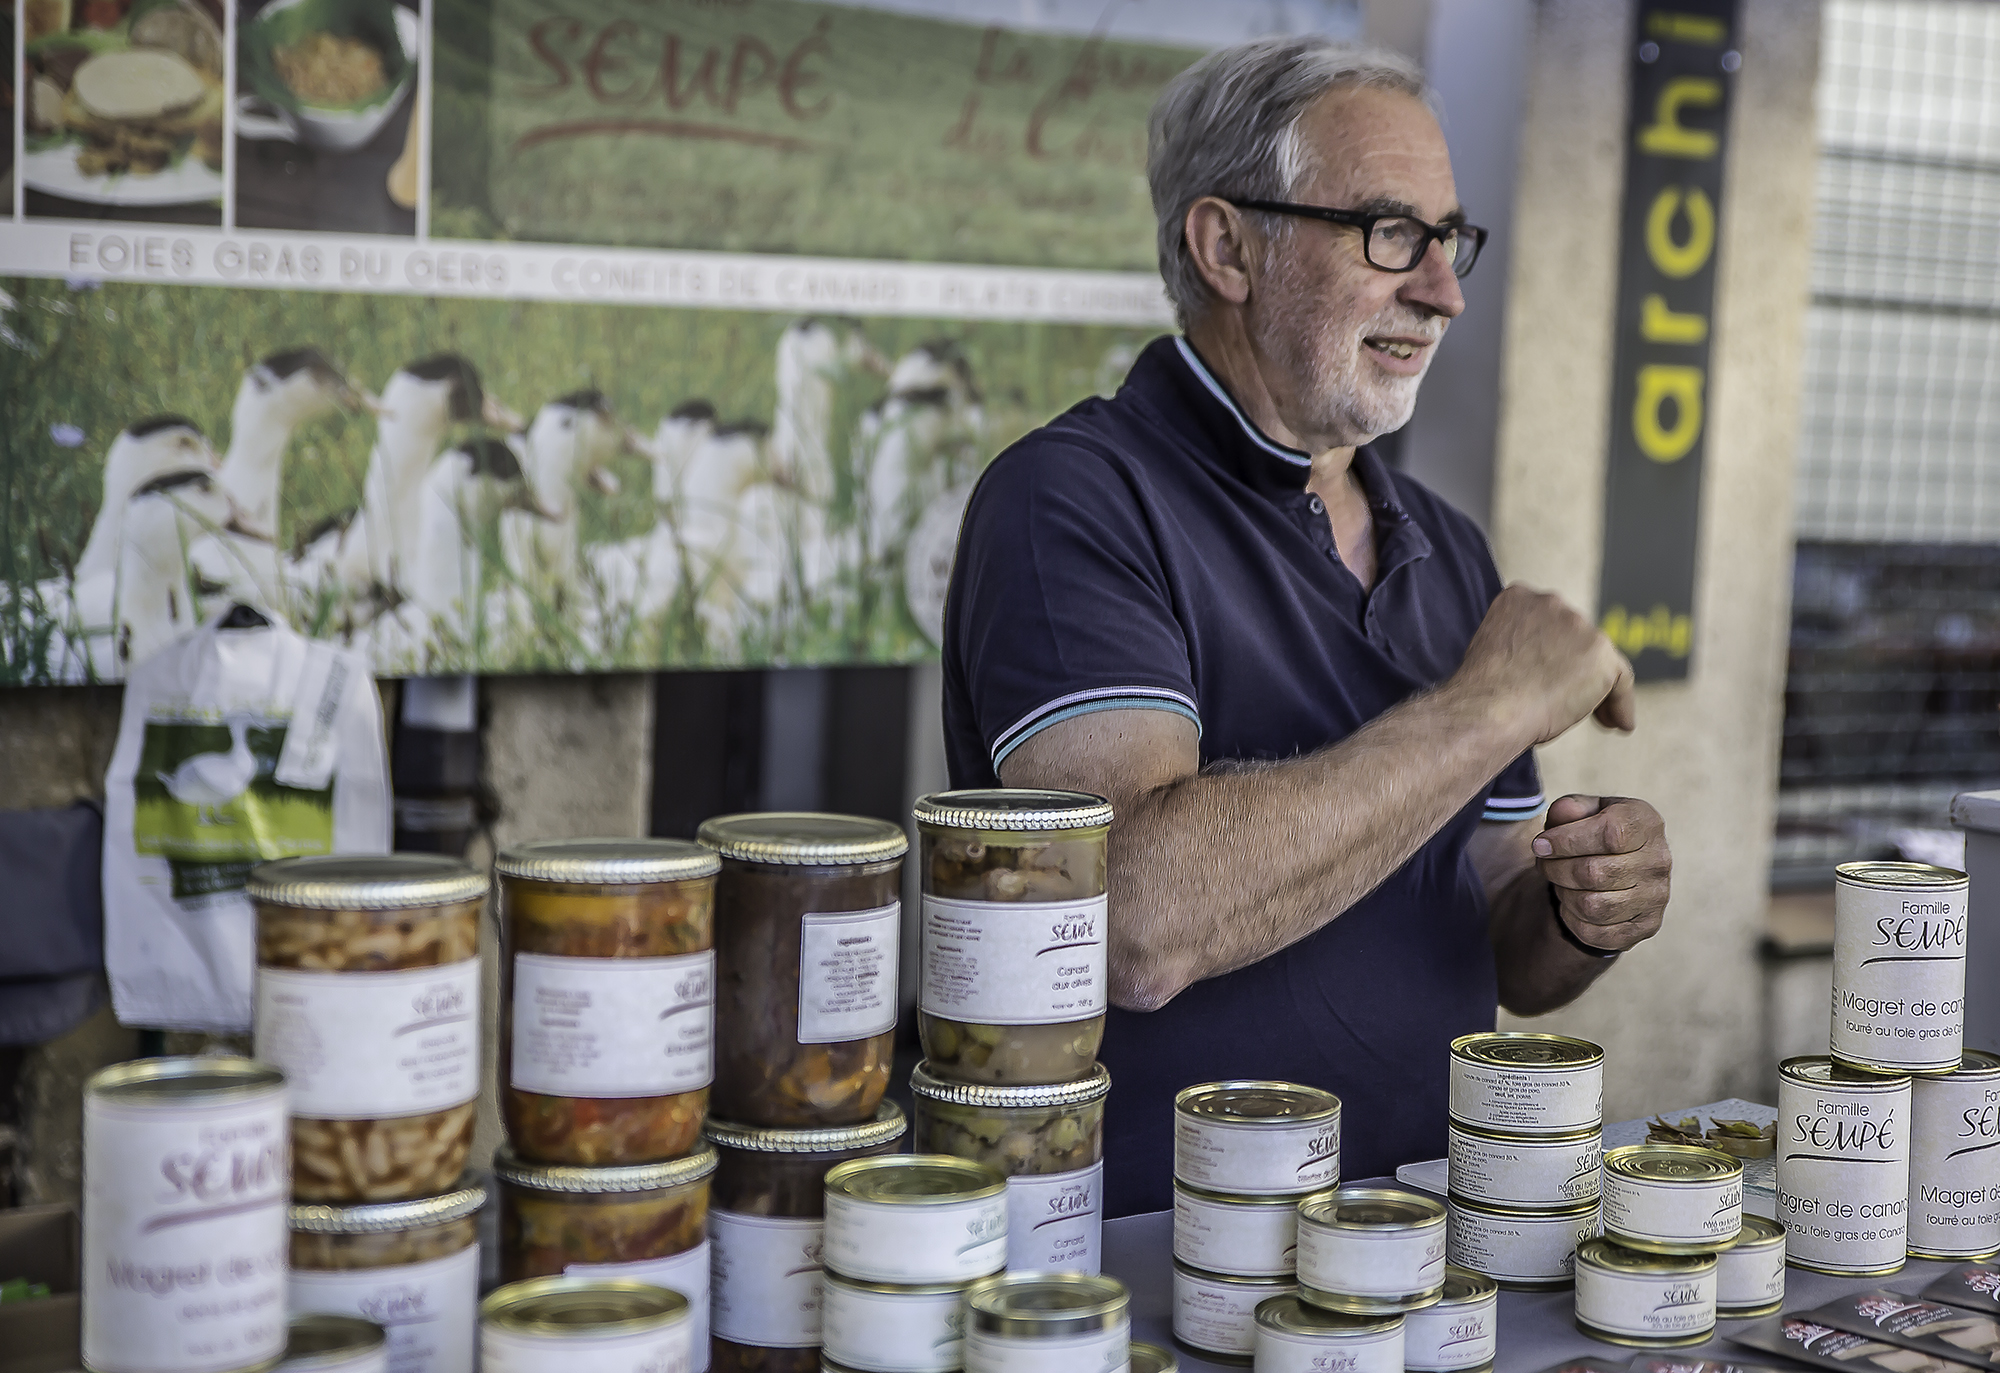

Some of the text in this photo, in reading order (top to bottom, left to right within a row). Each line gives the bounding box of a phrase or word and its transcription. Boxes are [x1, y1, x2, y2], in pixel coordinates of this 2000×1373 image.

[512, 12, 839, 122] SEMPÉ
[1633, 12, 1726, 464] archi
[68, 233, 197, 275] FOIES
[212, 240, 325, 283] GRAS
[339, 247, 392, 286] DU
[1902, 901, 1950, 915] Famille
[1871, 906, 1965, 950] SEMPÉ
[1842, 990, 1964, 1017] Magret de can
[1846, 1019, 1872, 1034] fourré
[1875, 1027, 1891, 1037] au
[1894, 1027, 1915, 1038] foie
[1918, 1028, 1940, 1041] gras
[1817, 1099, 1870, 1117] Famille
[1791, 1108, 1895, 1151] SEMPÉ
[1575, 1149, 1602, 1172] SEMP
[1920, 1184, 1986, 1208] Magret
[1825, 1200, 1854, 1218] de
[1926, 1213, 1959, 1226] fourré
[1961, 1214, 1976, 1226] au
[1794, 1223, 1807, 1235] au
[1810, 1224, 1831, 1239] foie
[1834, 1227, 1859, 1242] gras
[1861, 1229, 1877, 1241] de
[1663, 1284, 1700, 1304] SEMPÉ
